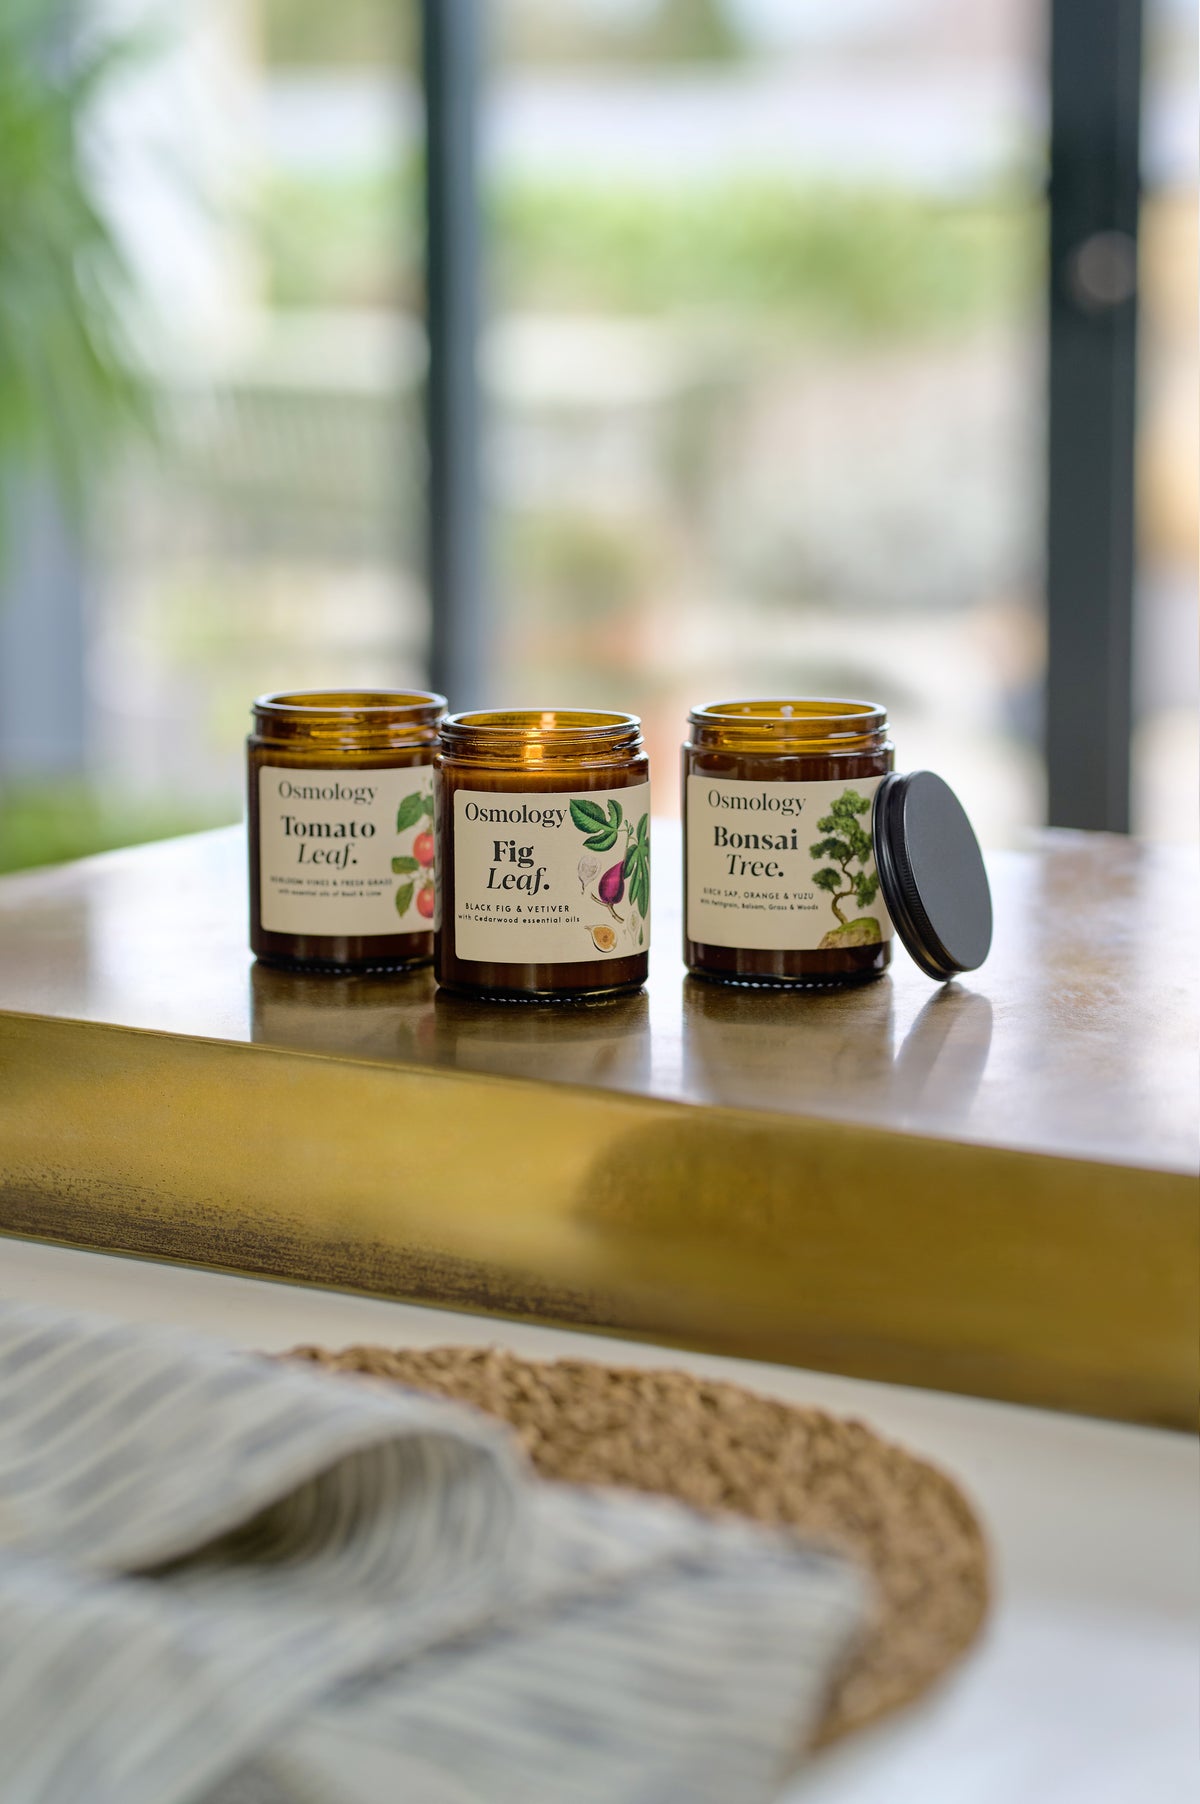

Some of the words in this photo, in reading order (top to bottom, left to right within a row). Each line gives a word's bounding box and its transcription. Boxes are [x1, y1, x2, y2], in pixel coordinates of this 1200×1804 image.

[279, 781, 378, 805] Osmology
[708, 789, 806, 816] Osmology
[280, 815, 376, 838] Tomato
[465, 802, 567, 828] Osmology
[713, 825, 798, 850] Bonsai
[298, 842, 358, 870] Leaf.
[493, 840, 535, 868] Fig
[726, 853, 784, 877] Tree.
[486, 867, 550, 896] Leaf.
[465, 902, 491, 912] BLACK
[495, 904, 511, 913] FIG
[516, 905, 522, 913] &
[527, 904, 570, 913] VETIVER
[743, 891, 779, 900] ORANGE
[783, 892, 789, 900] &
[793, 892, 814, 900] YUZU
[768, 903, 787, 911] Grass
[474, 914, 518, 924] Cedarwood
[522, 916, 561, 924] essential
[565, 915, 580, 923] oils
